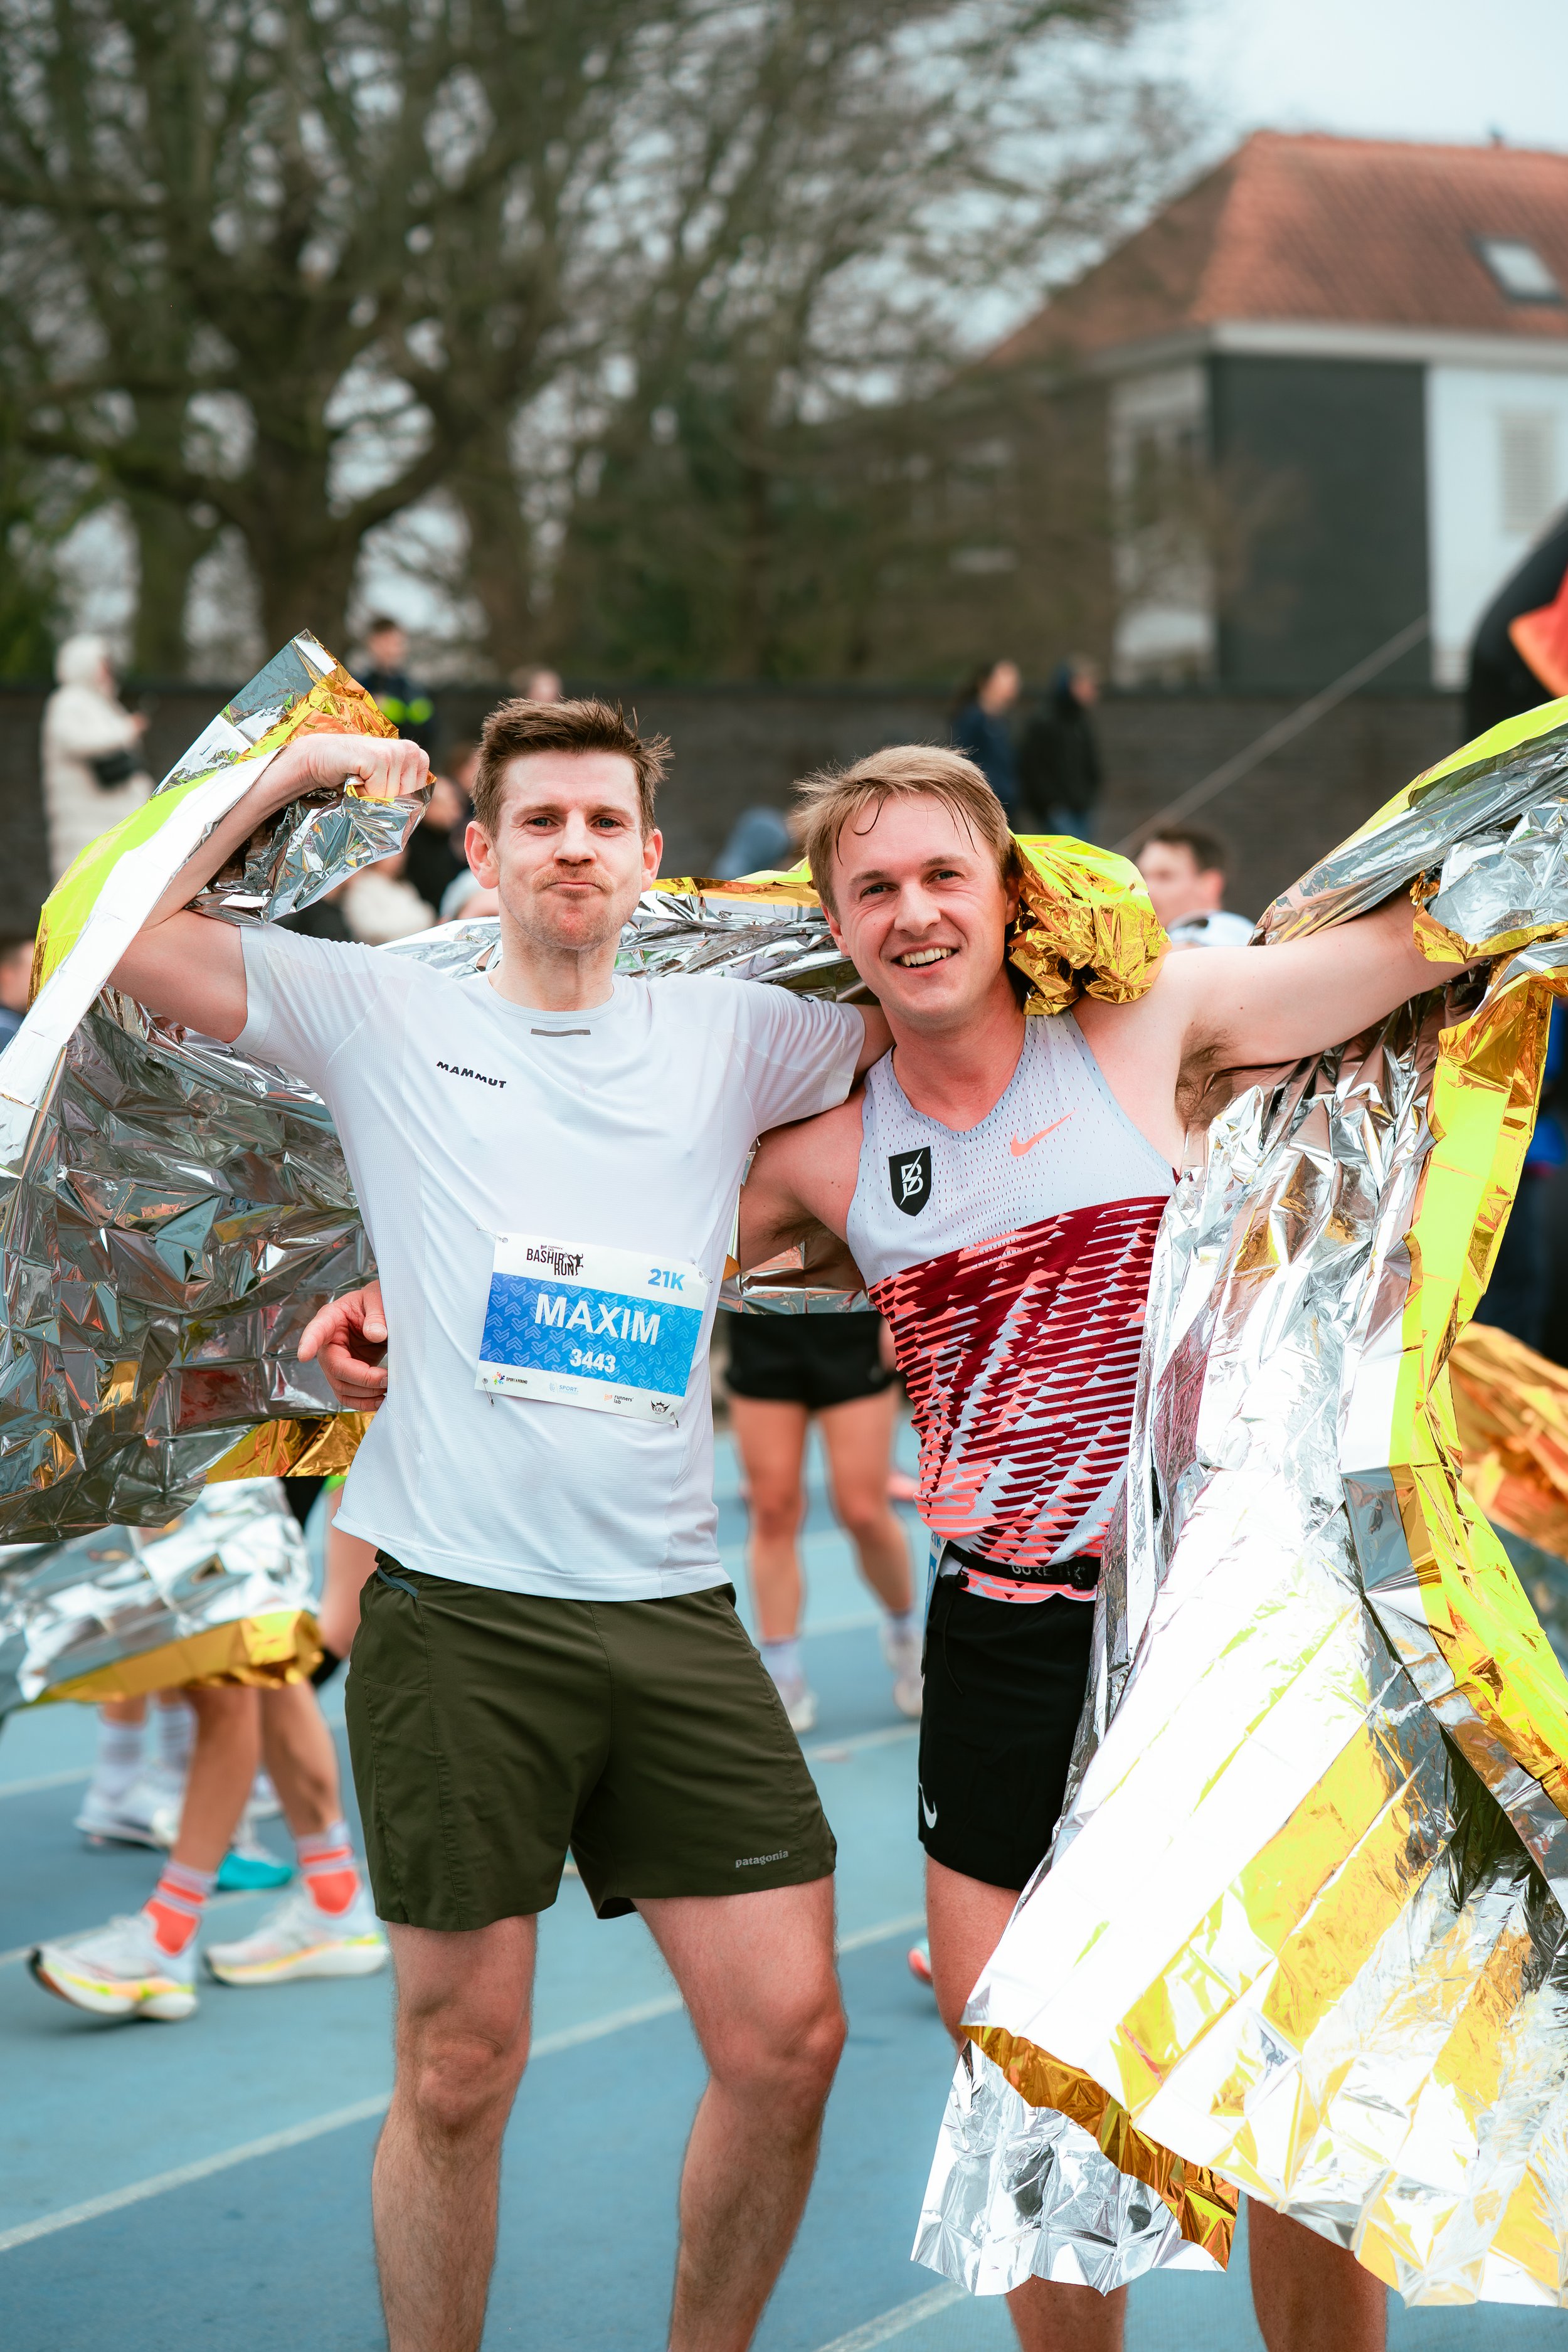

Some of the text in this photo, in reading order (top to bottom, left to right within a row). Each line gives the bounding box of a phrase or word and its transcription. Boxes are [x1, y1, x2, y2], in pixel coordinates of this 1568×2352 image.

[437, 1061, 506, 1088] MAMMUT
[554, 1263, 574, 1276] RUN
[648, 1268, 685, 1291] 21K
[534, 1293, 661, 1345] MAXIM
[569, 1348, 617, 1373] 3443
[735, 1850, 789, 1868] patagonia
